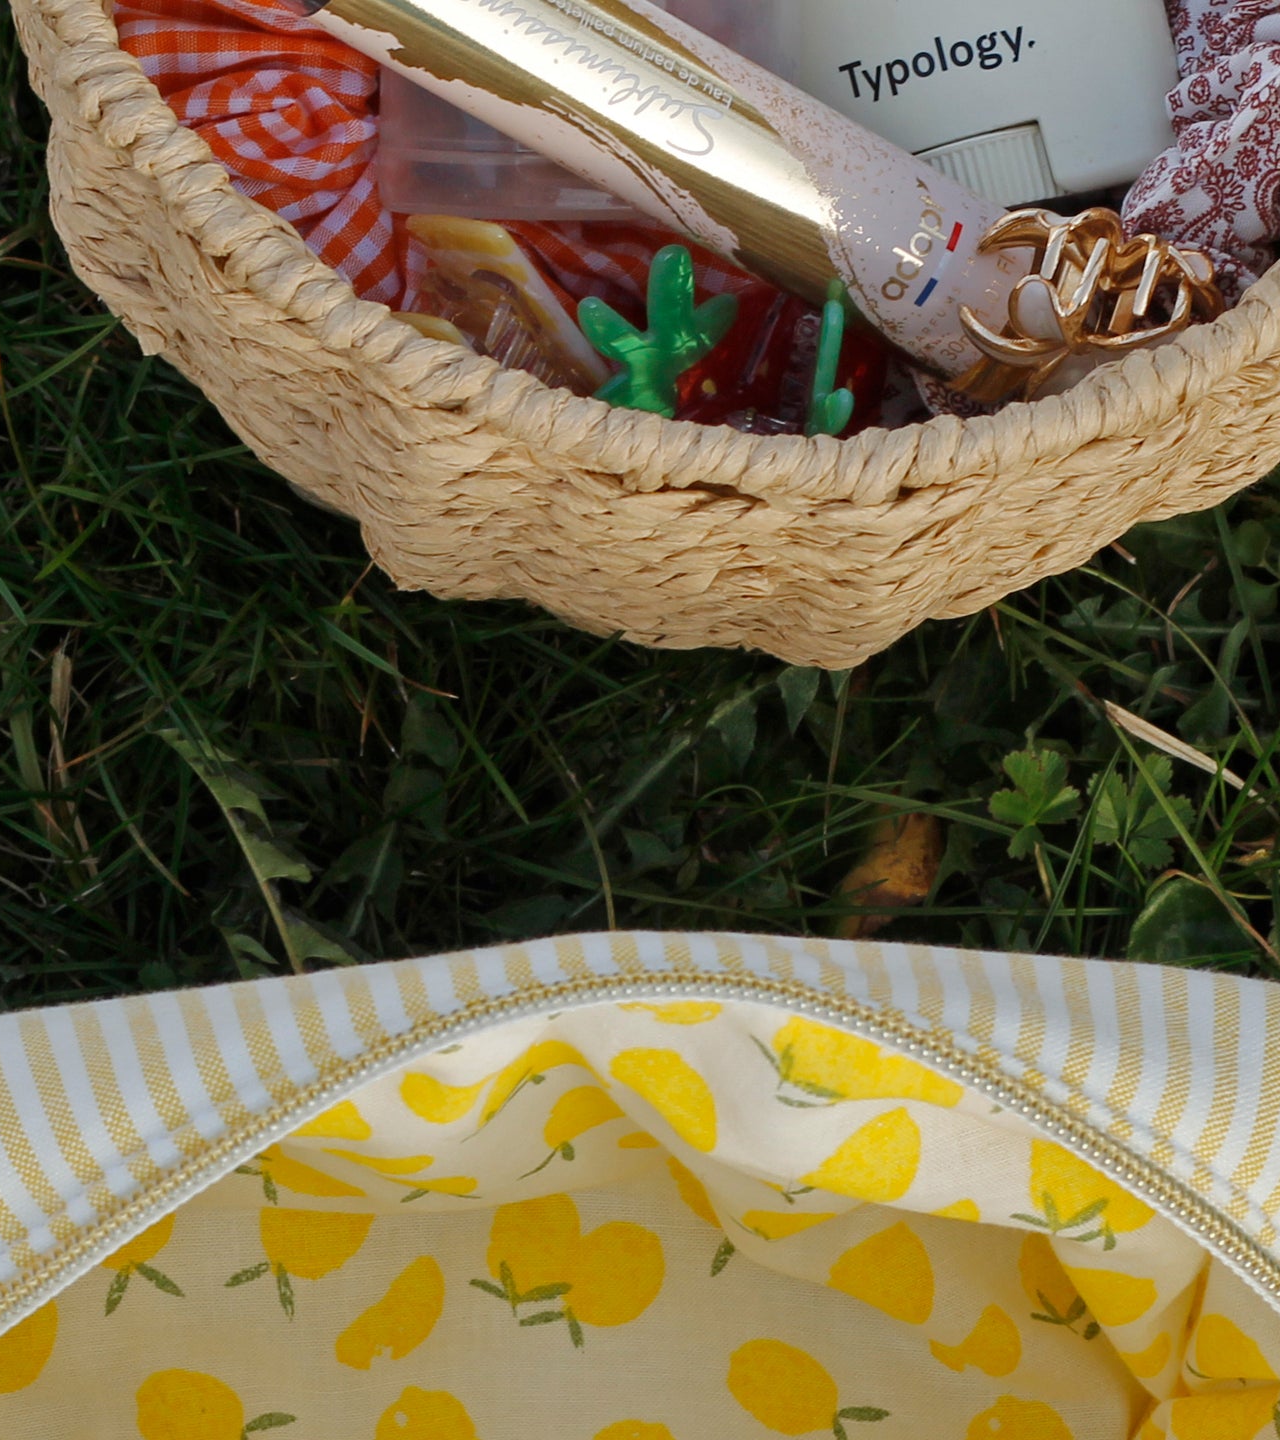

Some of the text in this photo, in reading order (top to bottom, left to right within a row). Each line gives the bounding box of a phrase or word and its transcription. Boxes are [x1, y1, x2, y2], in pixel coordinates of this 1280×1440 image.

[615, 34, 673, 72] parfum
[840, 25, 1035, 100] Typology.
[677, 66, 699, 85] de
[704, 80, 734, 108] Eau
